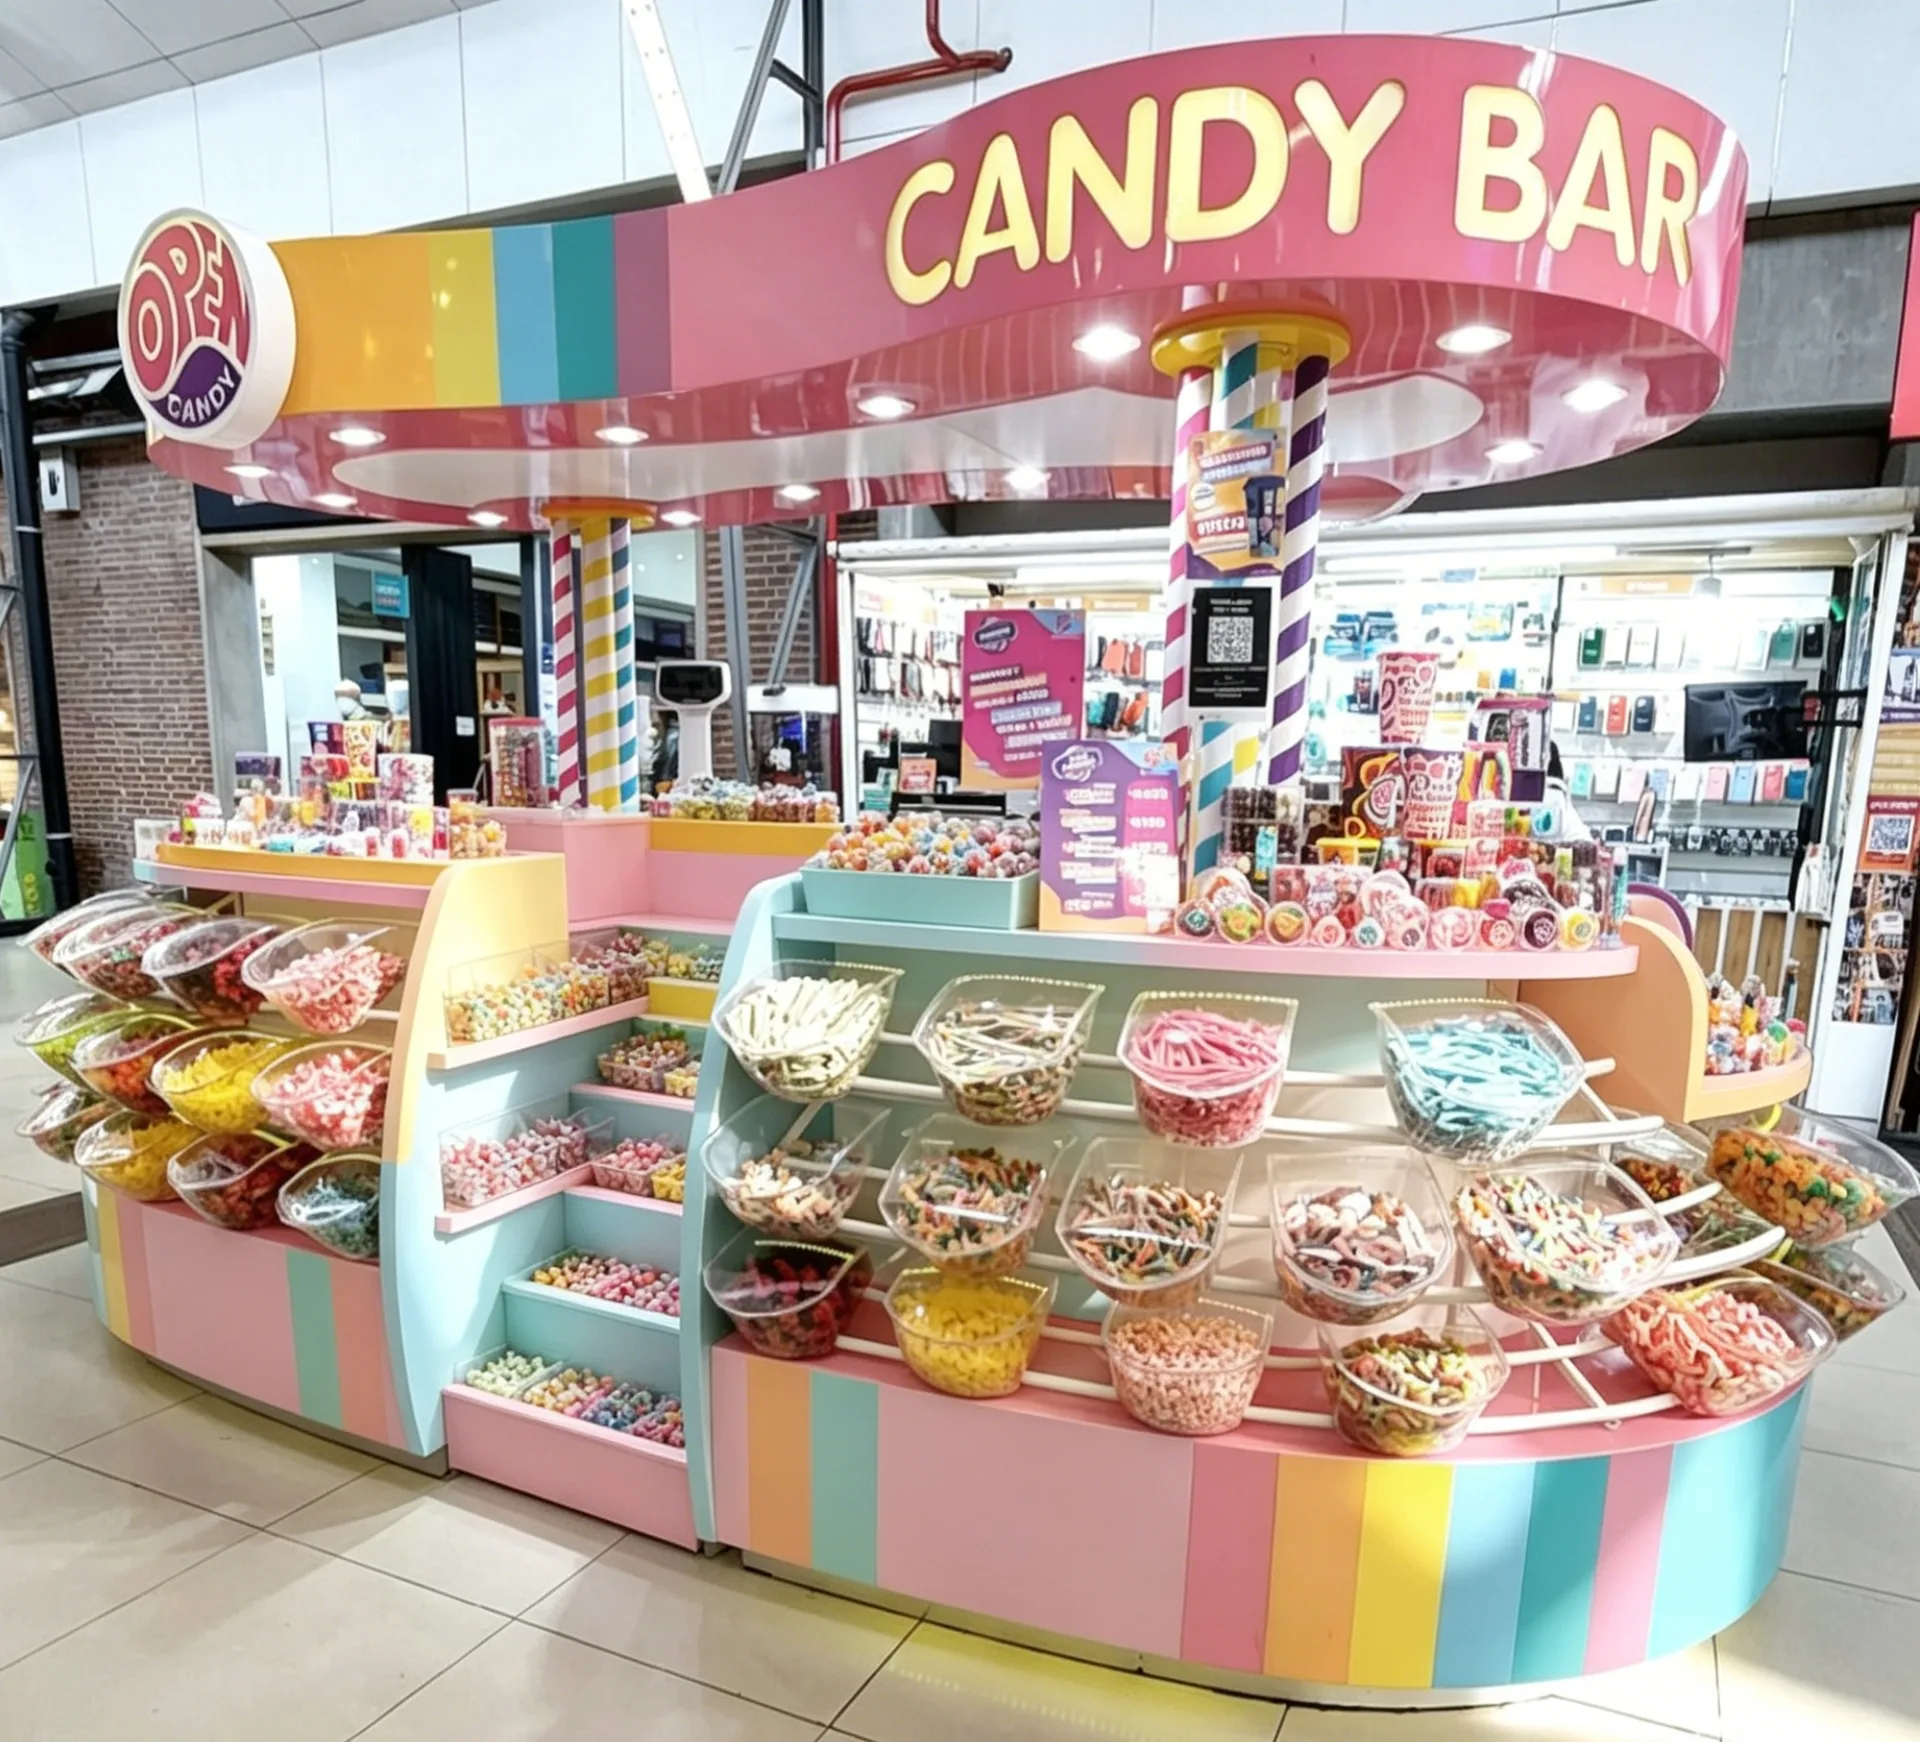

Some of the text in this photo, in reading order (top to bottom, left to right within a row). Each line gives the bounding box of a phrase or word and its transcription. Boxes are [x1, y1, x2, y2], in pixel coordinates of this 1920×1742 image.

[885, 79, 1700, 305] CANDY BAR
[127, 220, 252, 395] OPEN
[166, 364, 236, 425] CANDY
